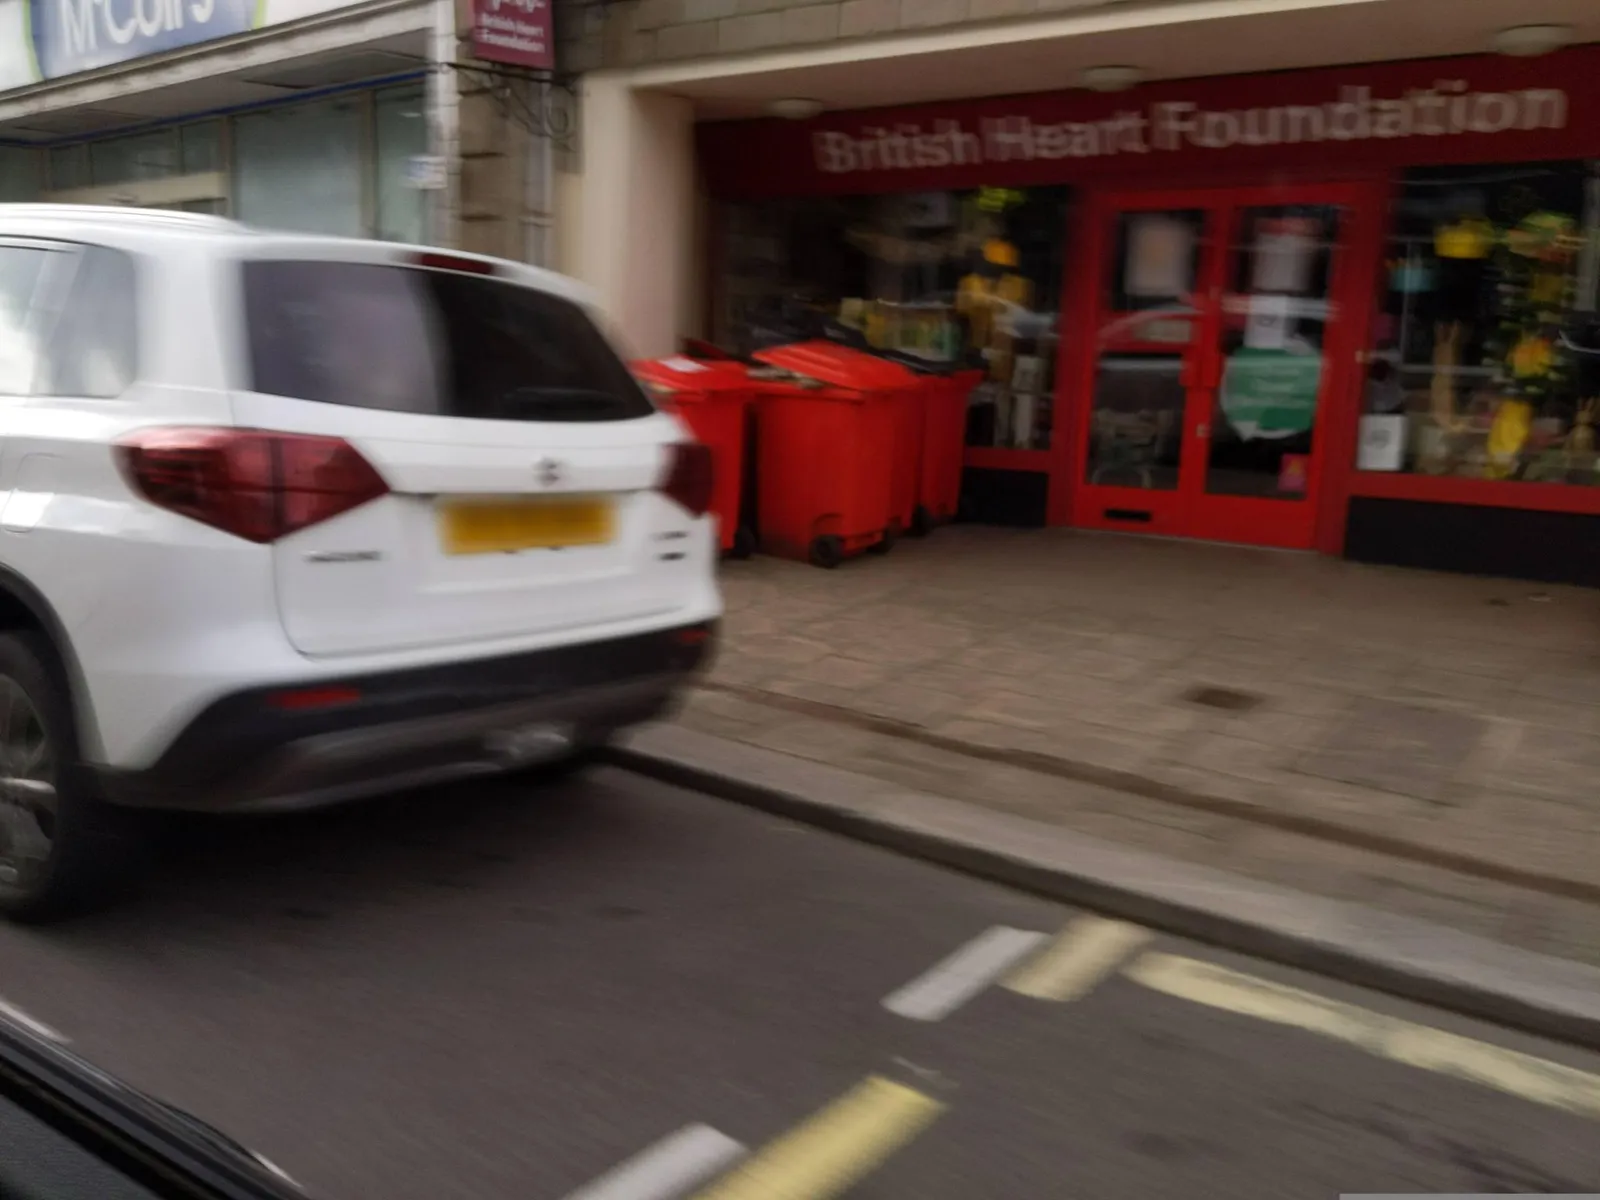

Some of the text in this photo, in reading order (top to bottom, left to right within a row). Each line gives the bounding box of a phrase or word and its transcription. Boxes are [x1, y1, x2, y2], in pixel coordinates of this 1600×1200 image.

[61, 0, 215, 56] MColls
[813, 79, 1568, 174] British Heart Foundation
